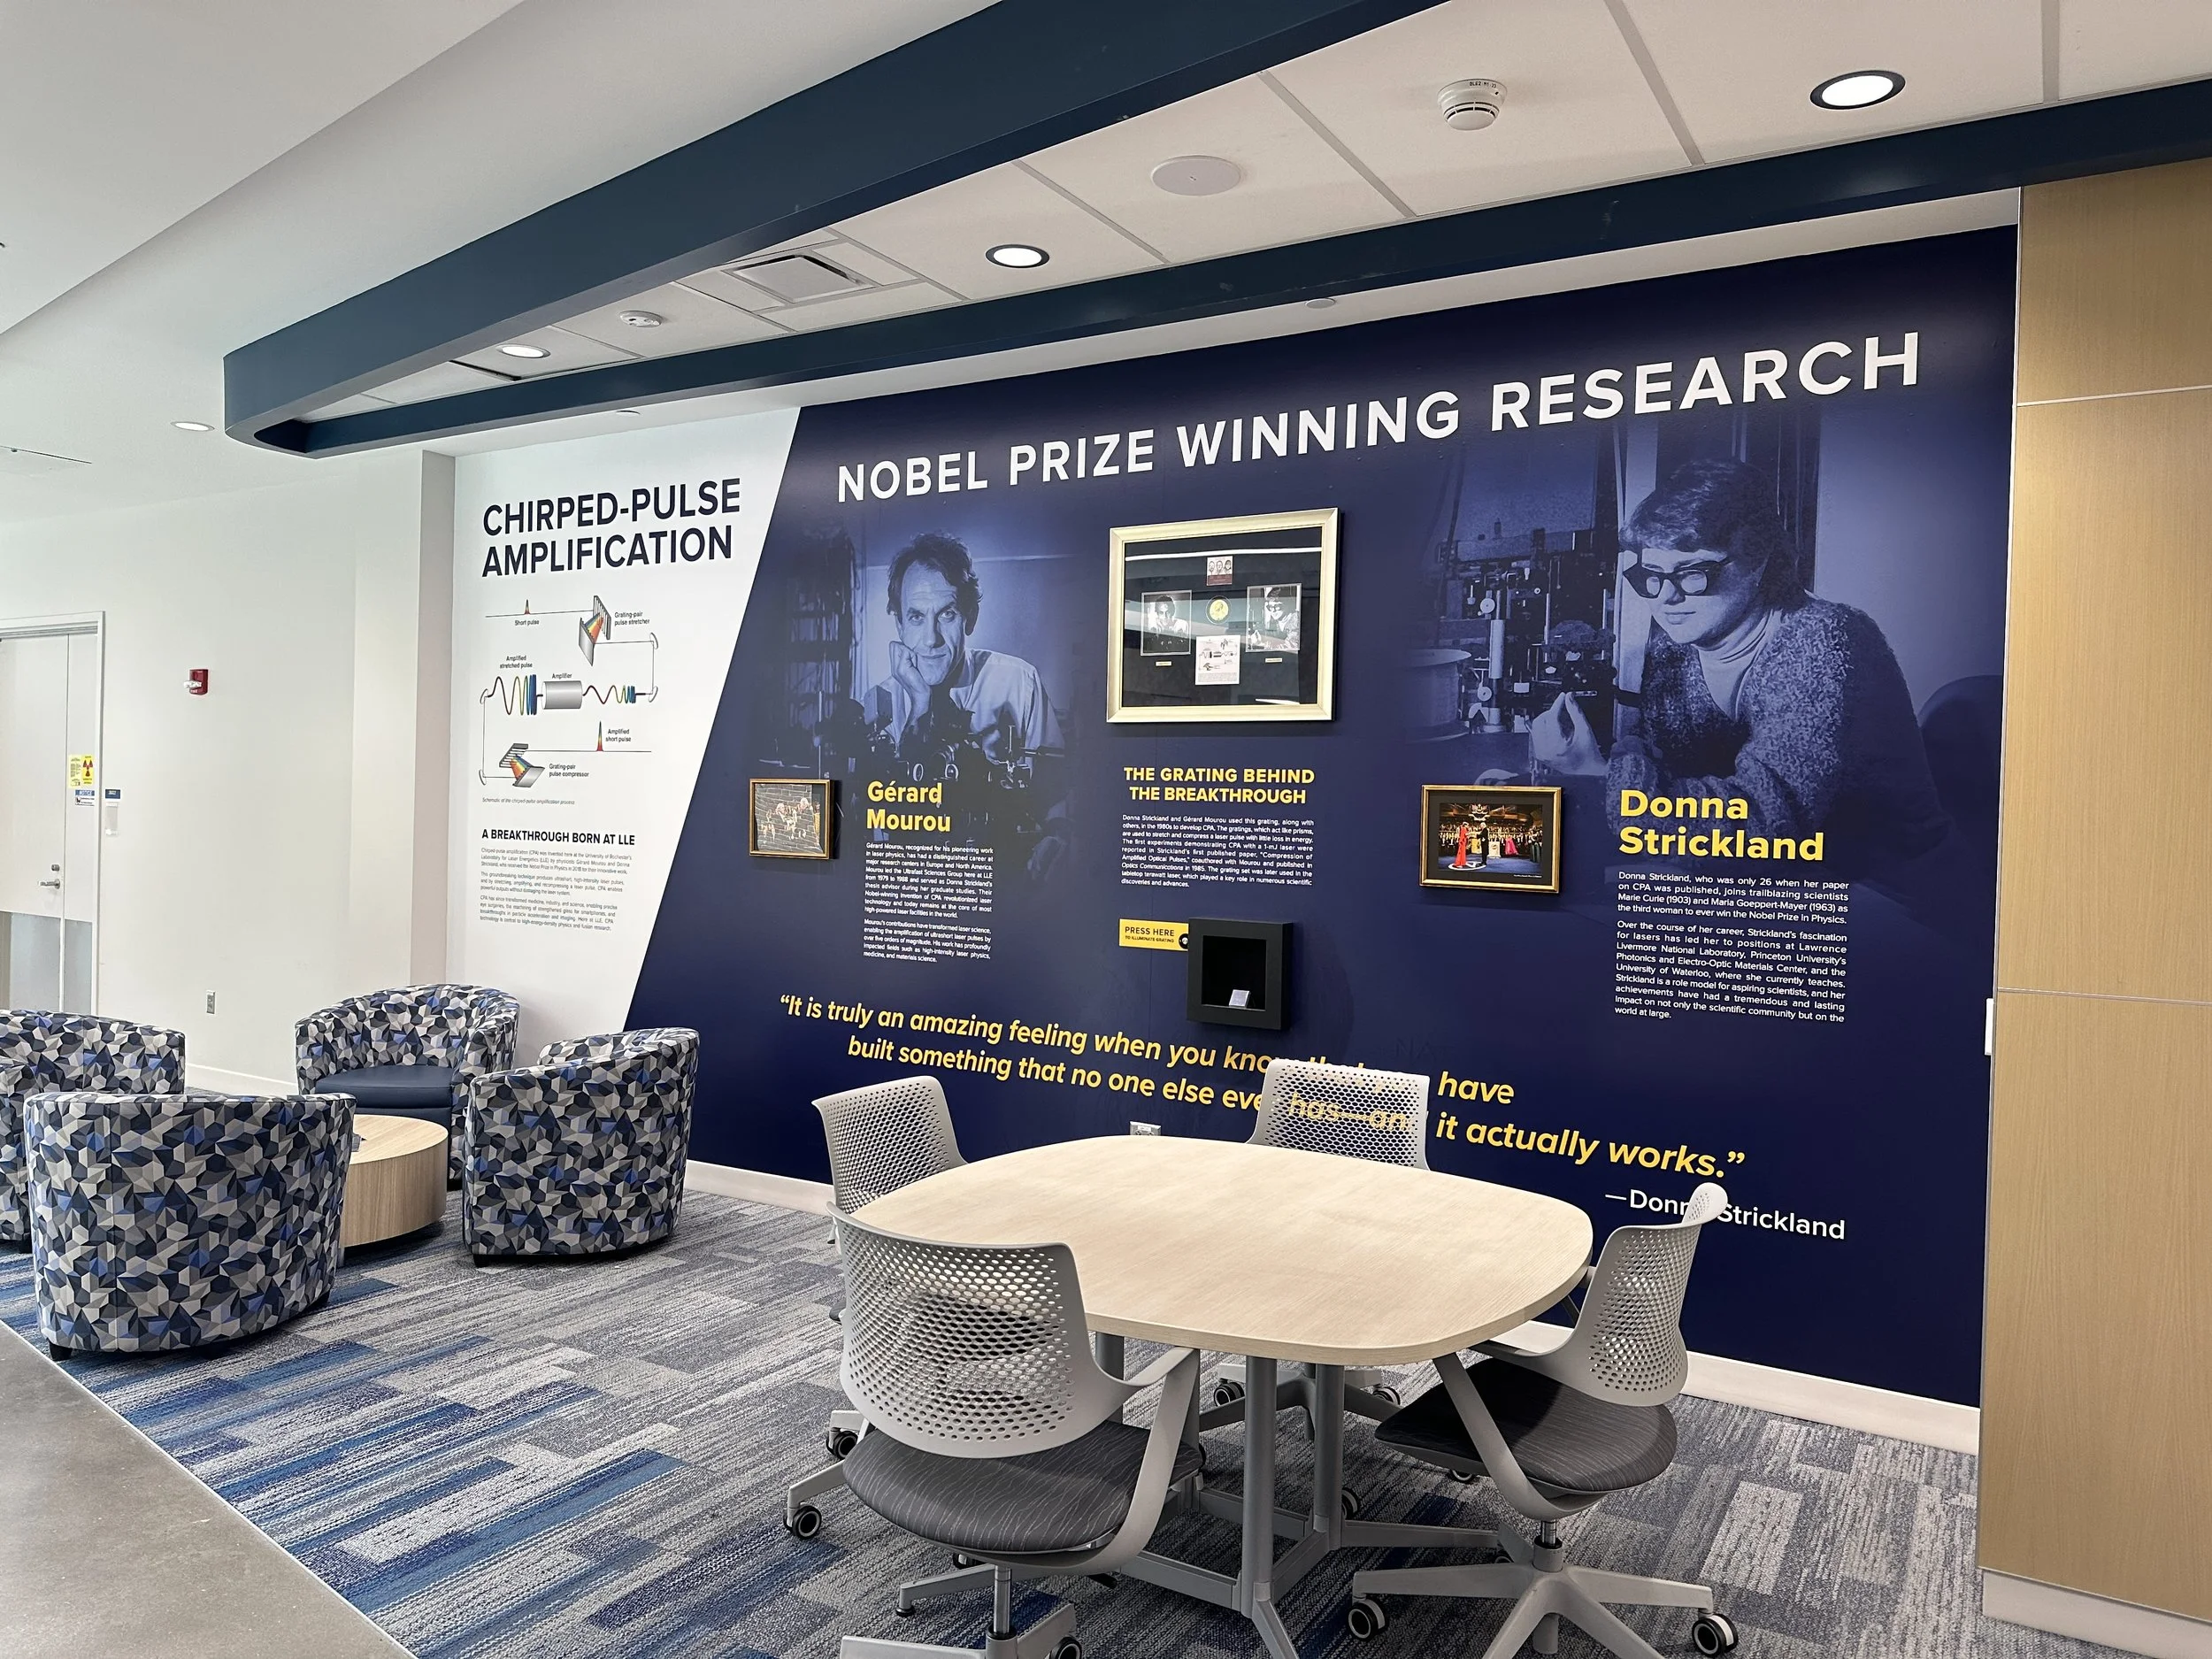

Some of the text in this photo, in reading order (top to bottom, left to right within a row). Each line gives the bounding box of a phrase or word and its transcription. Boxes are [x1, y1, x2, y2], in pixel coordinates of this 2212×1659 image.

[838, 332, 1918, 503] NOBEL PRIZE WINNING RESEARCH
[483, 478, 741, 536] CHIRPED-PULSE
[482, 525, 732, 577] AMPLIFICATION
[1124, 767, 1315, 784] THE GRATING BEHIND
[867, 780, 942, 803] Gérard
[1129, 787, 1306, 803] THE BREAKTHROUGH
[1620, 789, 1748, 819] Donna
[866, 809, 951, 832] Mourou
[482, 829, 634, 845] A BREAKTHROUGH BORN AT LLE
[1184, 841, 1225, 849] demonstrating
[1619, 826, 1824, 861] Strickland
[1618, 872, 1645, 880] Donna
[1649, 873, 1691, 883] Strickland,
[1738, 877, 1755, 887] only
[1823, 882, 1848, 891] paper
[1632, 883, 1650, 892] CPA
[1674, 885, 1720, 896] published,
[1724, 887, 1746, 897] joins
[1749, 888, 1800, 900] trailblazing
[1804, 890, 1848, 900] scientists
[1642, 895, 1664, 903] Curie
[1666, 895, 1691, 906] (1903)
[1693, 896, 1709, 905] and
[1711, 897, 1733, 906] Maria
[1736, 899, 1807, 911] Goeppert-Mayer
[1809, 902, 1835, 912] (1963)
[1716, 909, 1731, 918] win
[1732, 910, 1747, 918] the
[1749, 910, 1775, 919] Nobel
[1777, 912, 1798, 921] Prize
[1811, 914, 1847, 925] Physics.
[1125, 926, 1175, 937] PRESS HERE
[1617, 931, 1629, 940] for
[1633, 932, 1660, 941] lasers
[1664, 933, 1680, 942] has
[1703, 936, 1719, 945] her
[1737, 939, 1780, 950] positions
[1799, 942, 1847, 953] Lawrence
[780, 995, 802, 1018] “It
[806, 997, 822, 1019] is
[827, 1002, 874, 1029] truly
[878, 1010, 902, 1028] an
[910, 1013, 1002, 1045] amazing
[1009, 1019, 1087, 1055] feeling
[1094, 1033, 1161, 1060] when
[1166, 1047, 1214, 1069] you
[1224, 1046, 1271, 1073] kno
[1437, 1071, 1515, 1104] have
[848, 1035, 895, 1060] built
[899, 1047, 1012, 1081] something
[1018, 1057, 1065, 1083] that
[1071, 1068, 1100, 1088] no
[1108, 1074, 1155, 1097] one
[1164, 1079, 1215, 1105] else
[1222, 1089, 1263, 1110] eve
[1436, 1111, 1456, 1141] it
[1465, 1119, 1600, 1166] actually
[1607, 1142, 1746, 1179] works.”
[1717, 1202, 1845, 1240] Strickland
